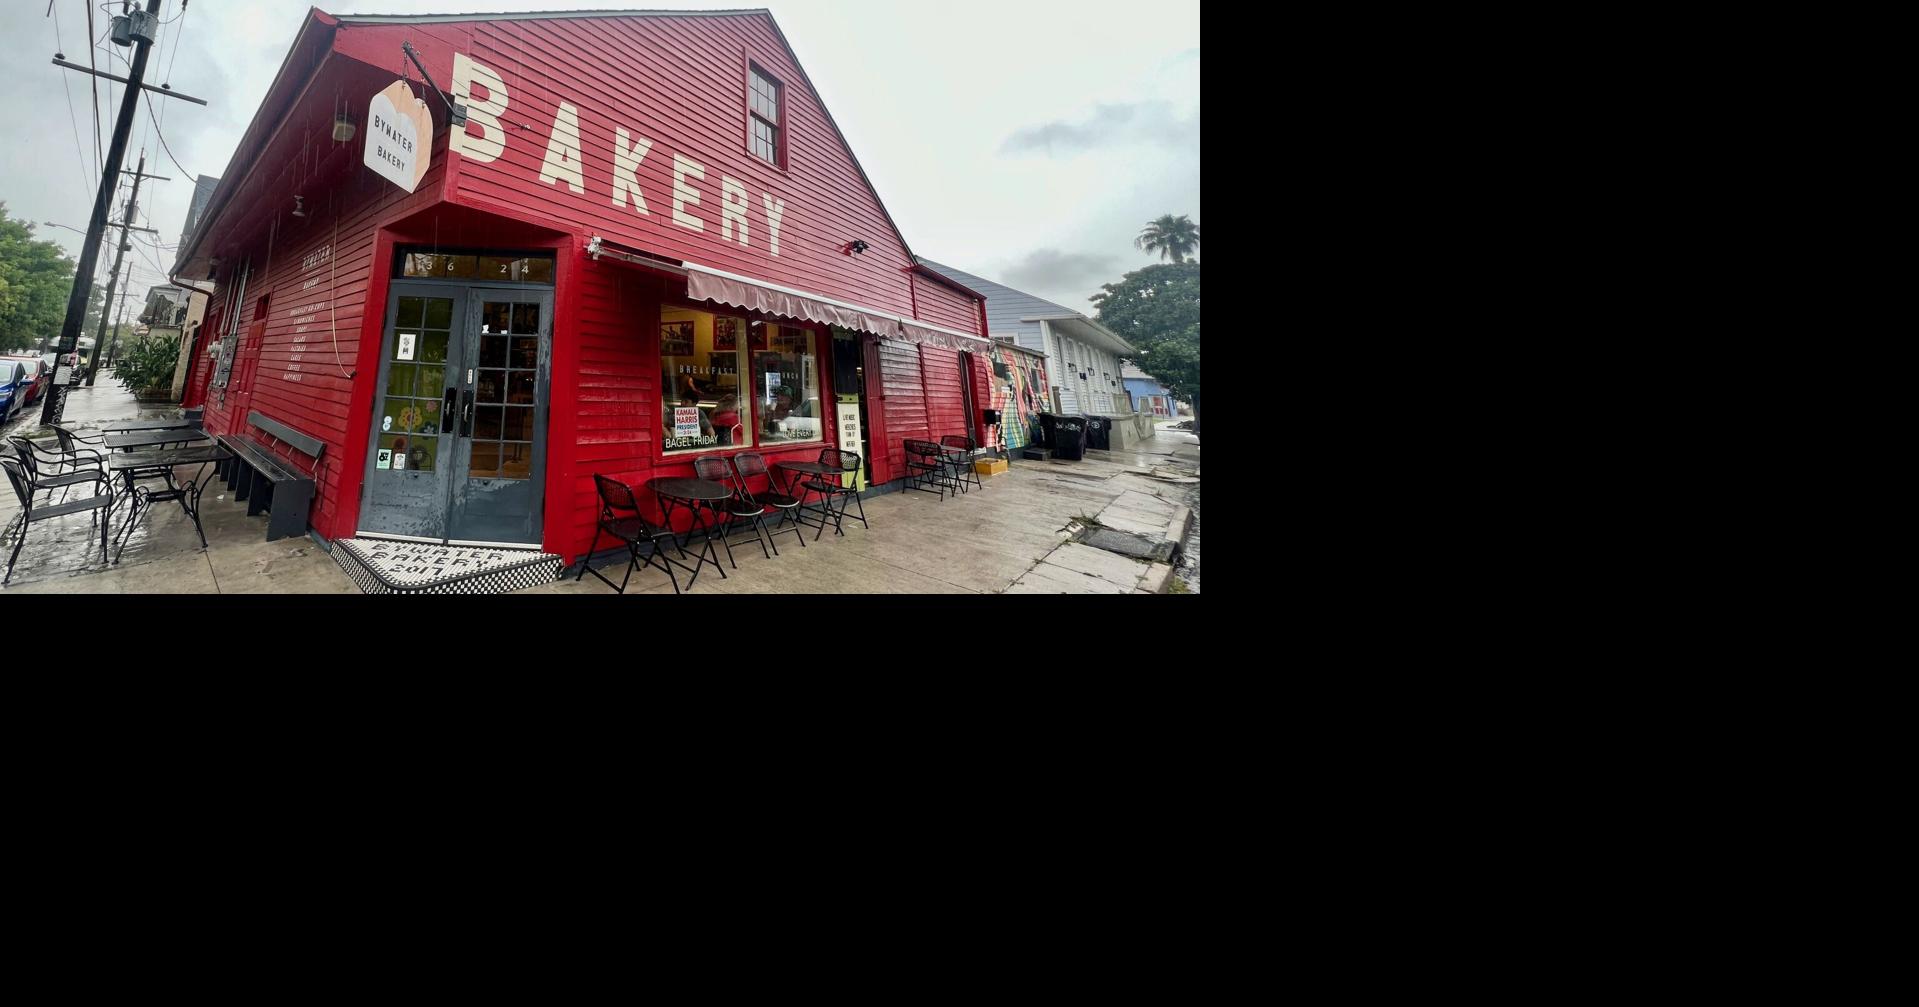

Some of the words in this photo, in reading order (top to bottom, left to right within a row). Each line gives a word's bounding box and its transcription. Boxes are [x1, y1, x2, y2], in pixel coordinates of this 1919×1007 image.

[374, 114, 413, 153] BYWATER
[377, 145, 405, 171] BAKERY
[449, 52, 785, 257] BAKERY
[680, 364, 734, 375] BREAKFAST
[676, 408, 697, 416] KAMALA
[676, 415, 698, 424] HARRIS
[665, 437, 691, 449] BAGEL
[693, 434, 719, 446] FRIDAY
[370, 551, 488, 568] BAKERY
[371, 543, 503, 561] BYWATER
